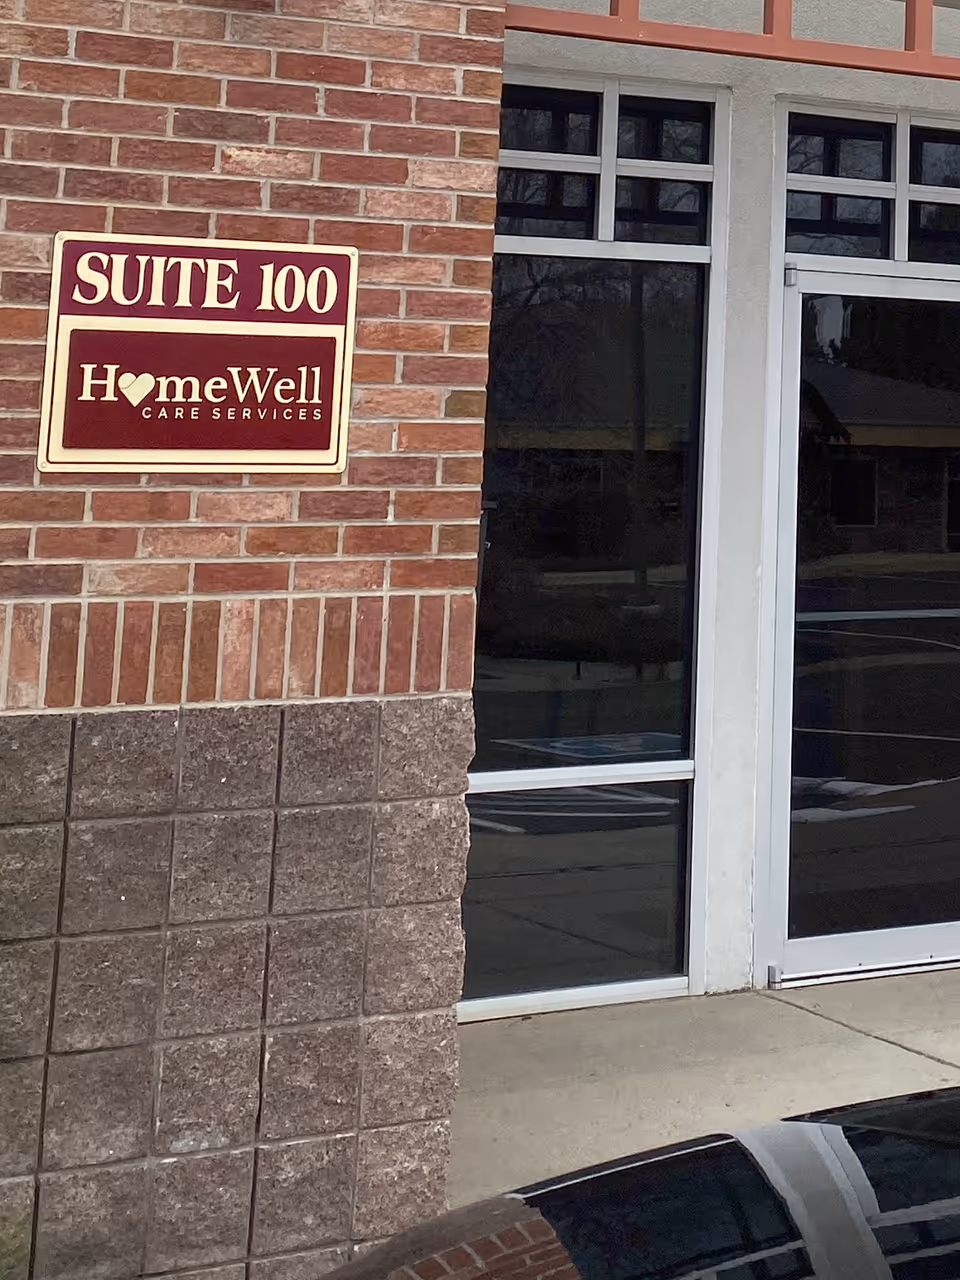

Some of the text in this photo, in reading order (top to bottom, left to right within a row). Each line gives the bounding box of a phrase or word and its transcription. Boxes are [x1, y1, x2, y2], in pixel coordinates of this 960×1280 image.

[72, 251, 338, 314] SUITE 100
[142, 406, 323, 421] CARE SERVICES
